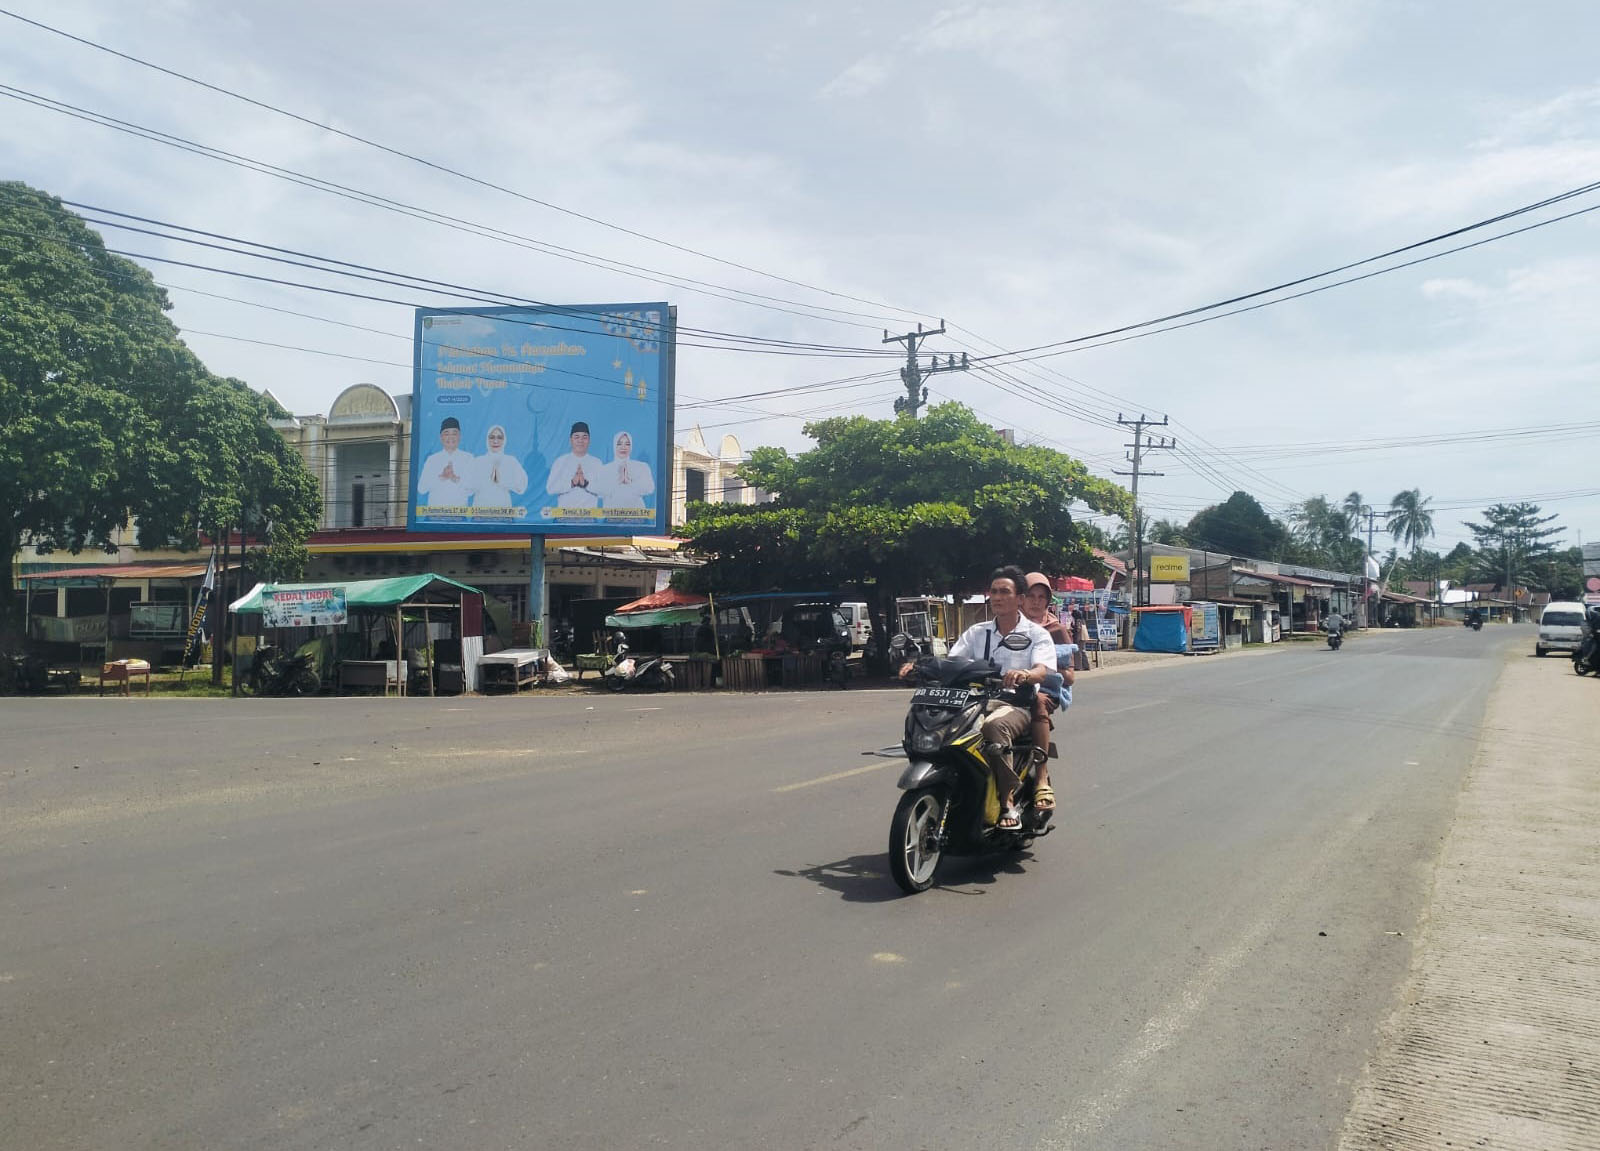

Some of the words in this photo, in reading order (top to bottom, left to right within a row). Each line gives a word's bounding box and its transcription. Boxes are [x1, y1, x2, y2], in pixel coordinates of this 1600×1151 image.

[1156, 563, 1183, 572] realme
[273, 592, 303, 603] KEDAI
[306, 590, 333, 601] INDRI
[187, 605, 207, 637] MOBIL
[1100, 628, 1117, 636] ATM
[929, 689, 951, 697] 6531
